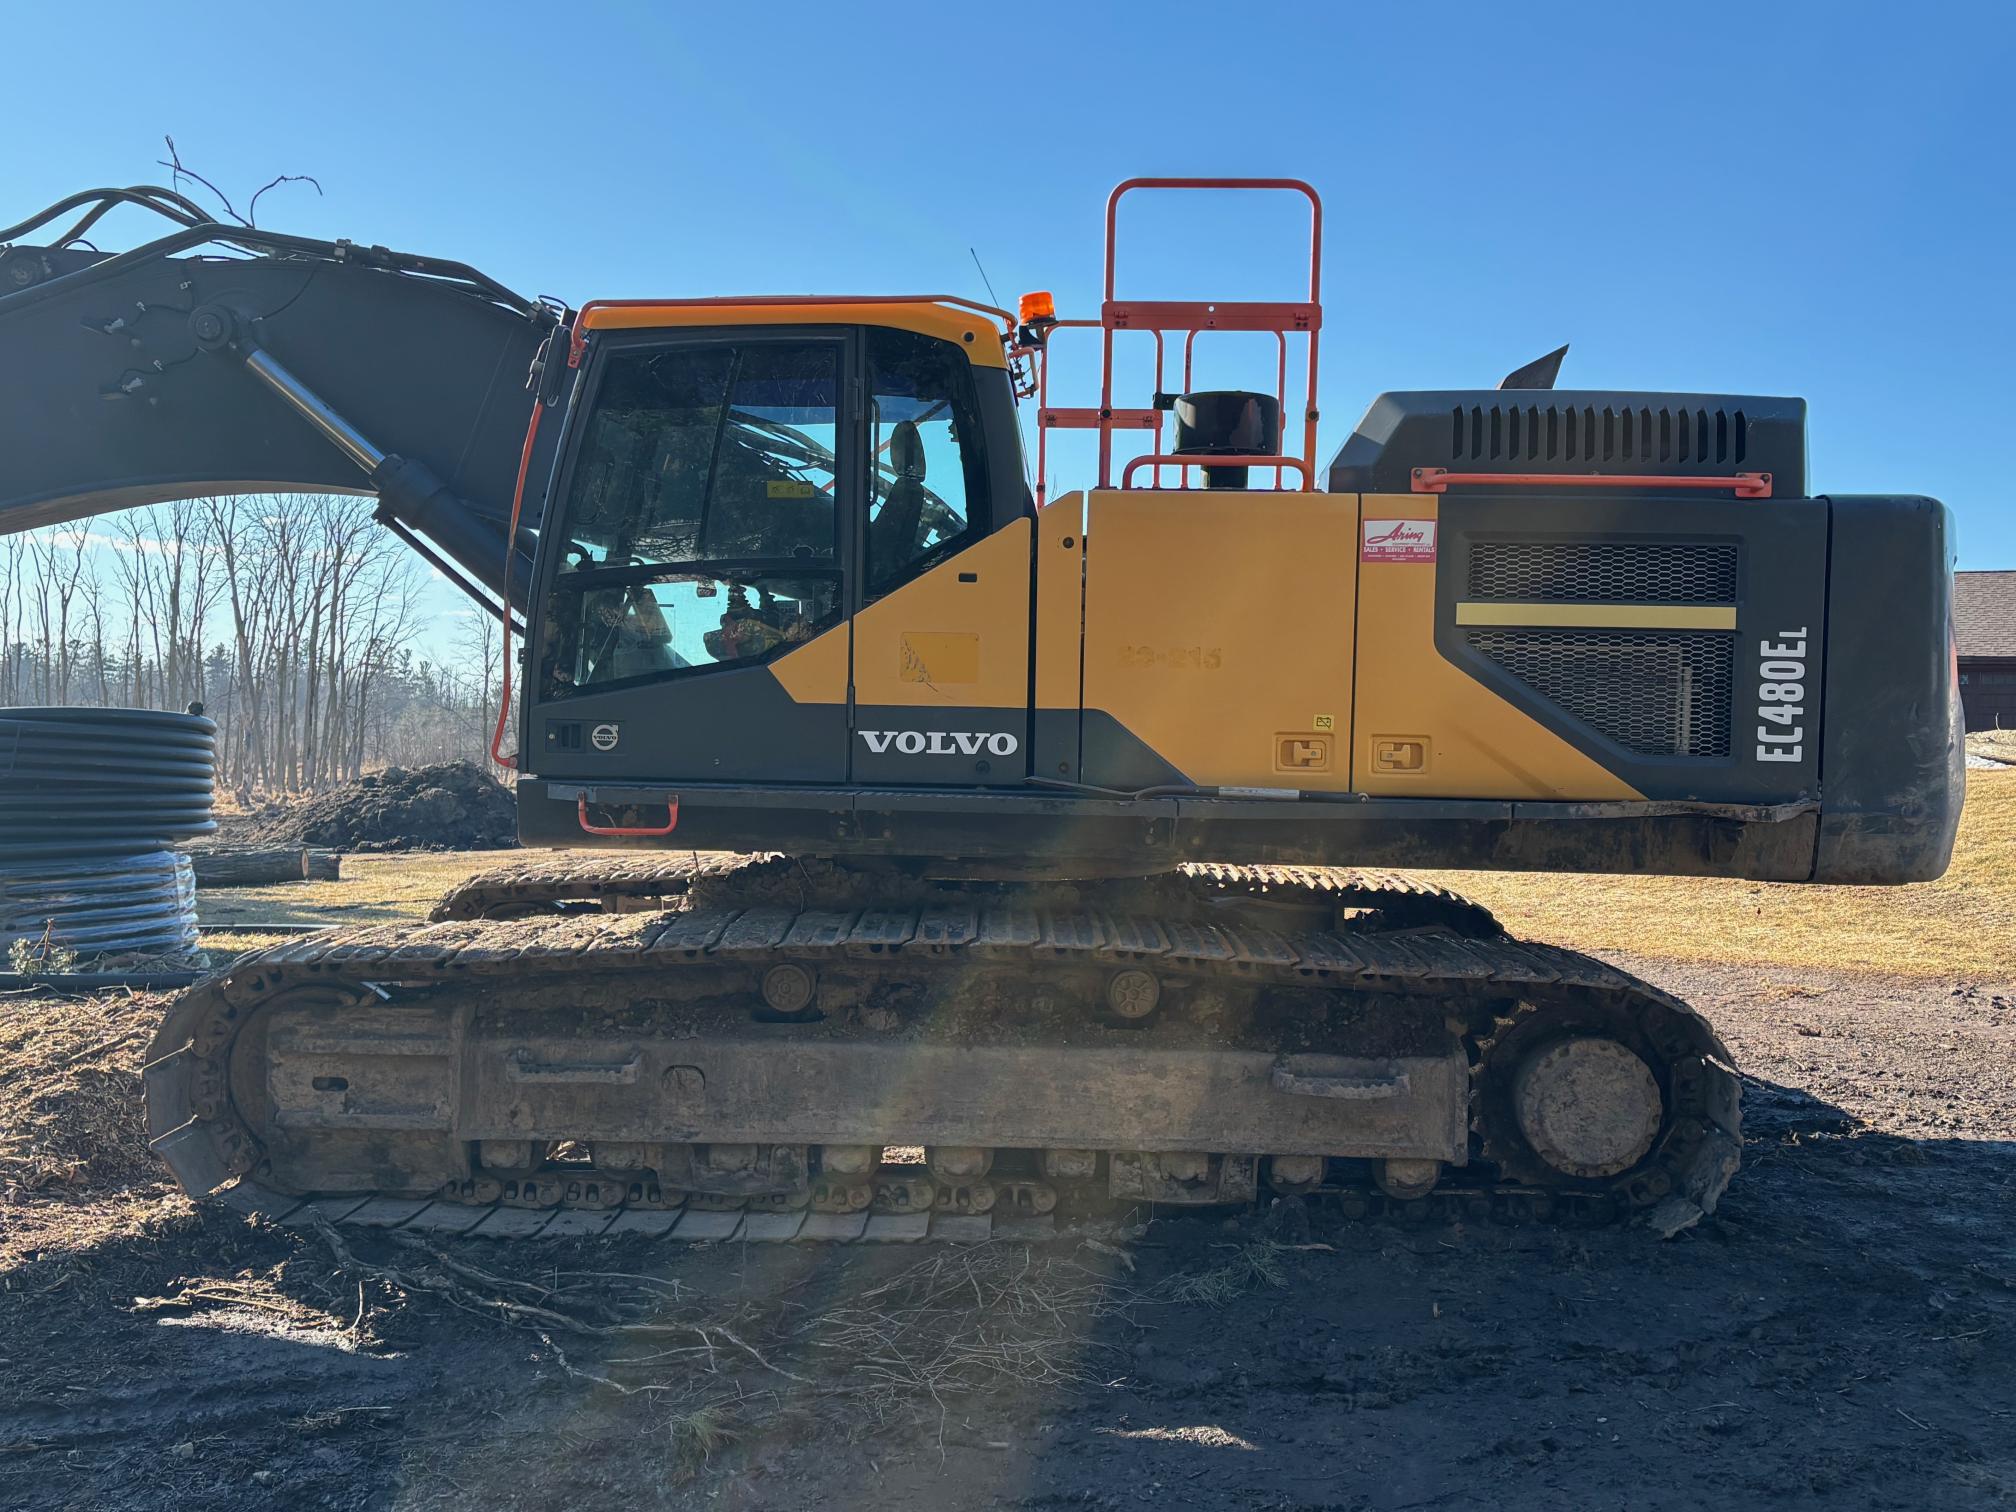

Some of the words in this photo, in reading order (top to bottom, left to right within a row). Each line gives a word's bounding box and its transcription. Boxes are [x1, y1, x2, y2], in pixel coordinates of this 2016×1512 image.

[1366, 521, 1425, 544] Aring
[1756, 626, 1808, 763] EC480EL
[857, 730, 1018, 756] VOLVO
